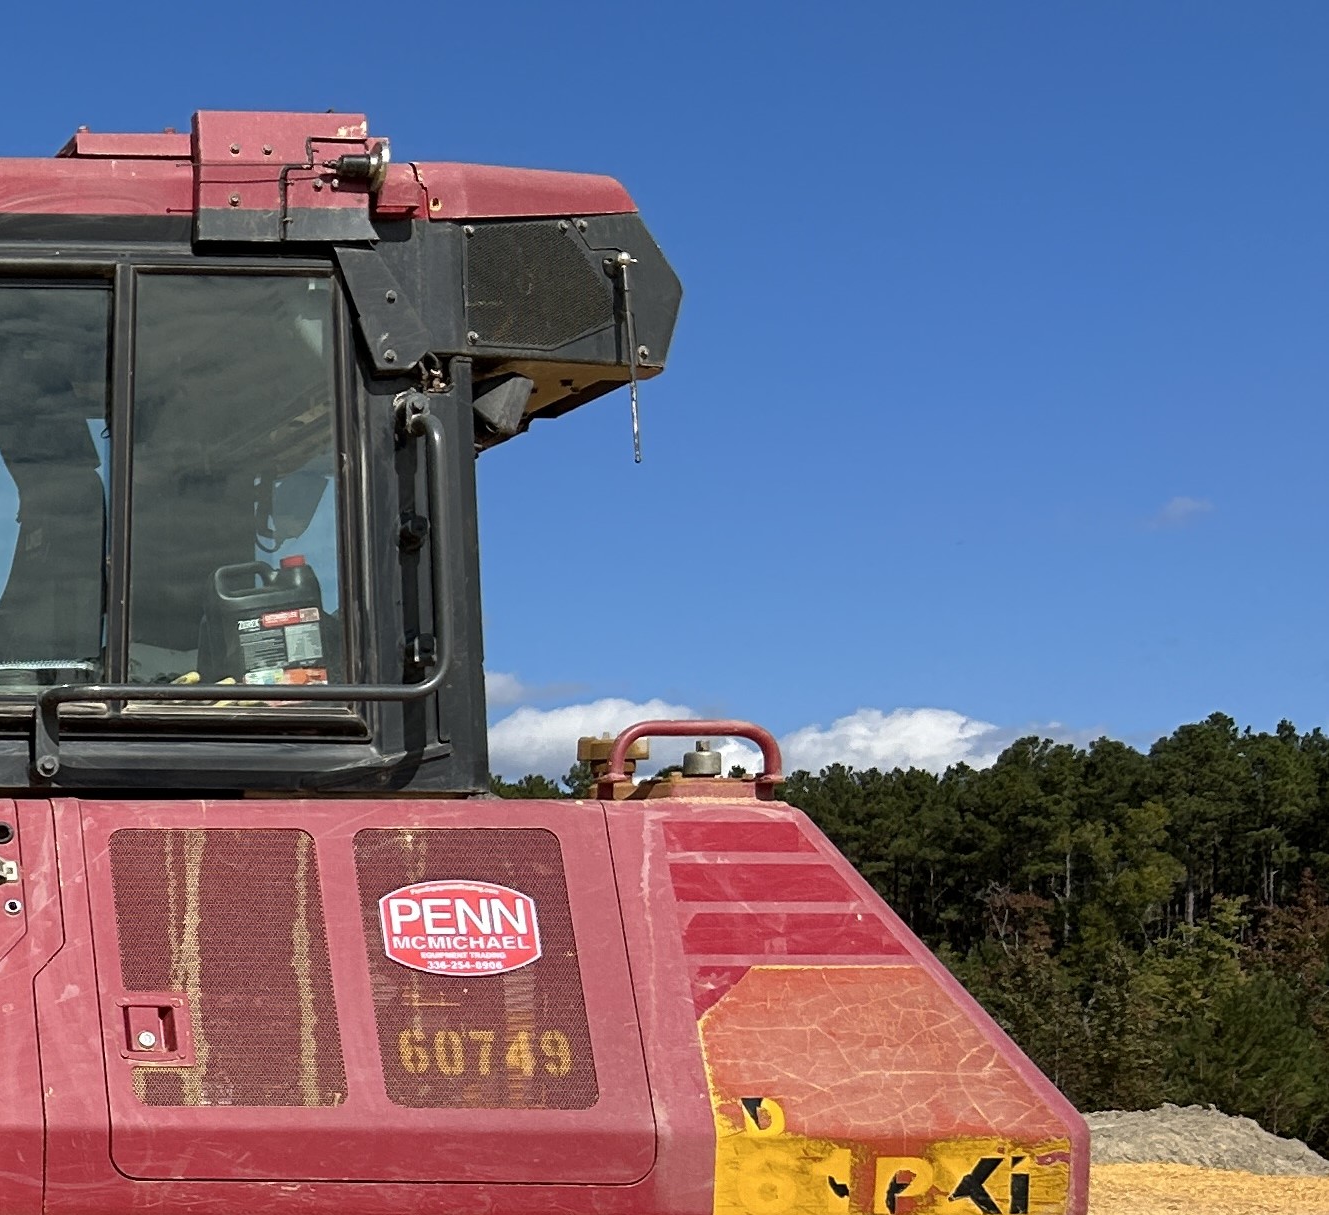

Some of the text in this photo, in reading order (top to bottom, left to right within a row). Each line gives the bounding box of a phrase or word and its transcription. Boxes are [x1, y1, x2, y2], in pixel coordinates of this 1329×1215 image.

[389, 898, 527, 935] PENN
[393, 936, 531, 950] MCMICHAEL
[421, 951, 507, 960] EQUIPMENT TRADING
[397, 1029, 573, 1077] 60749
